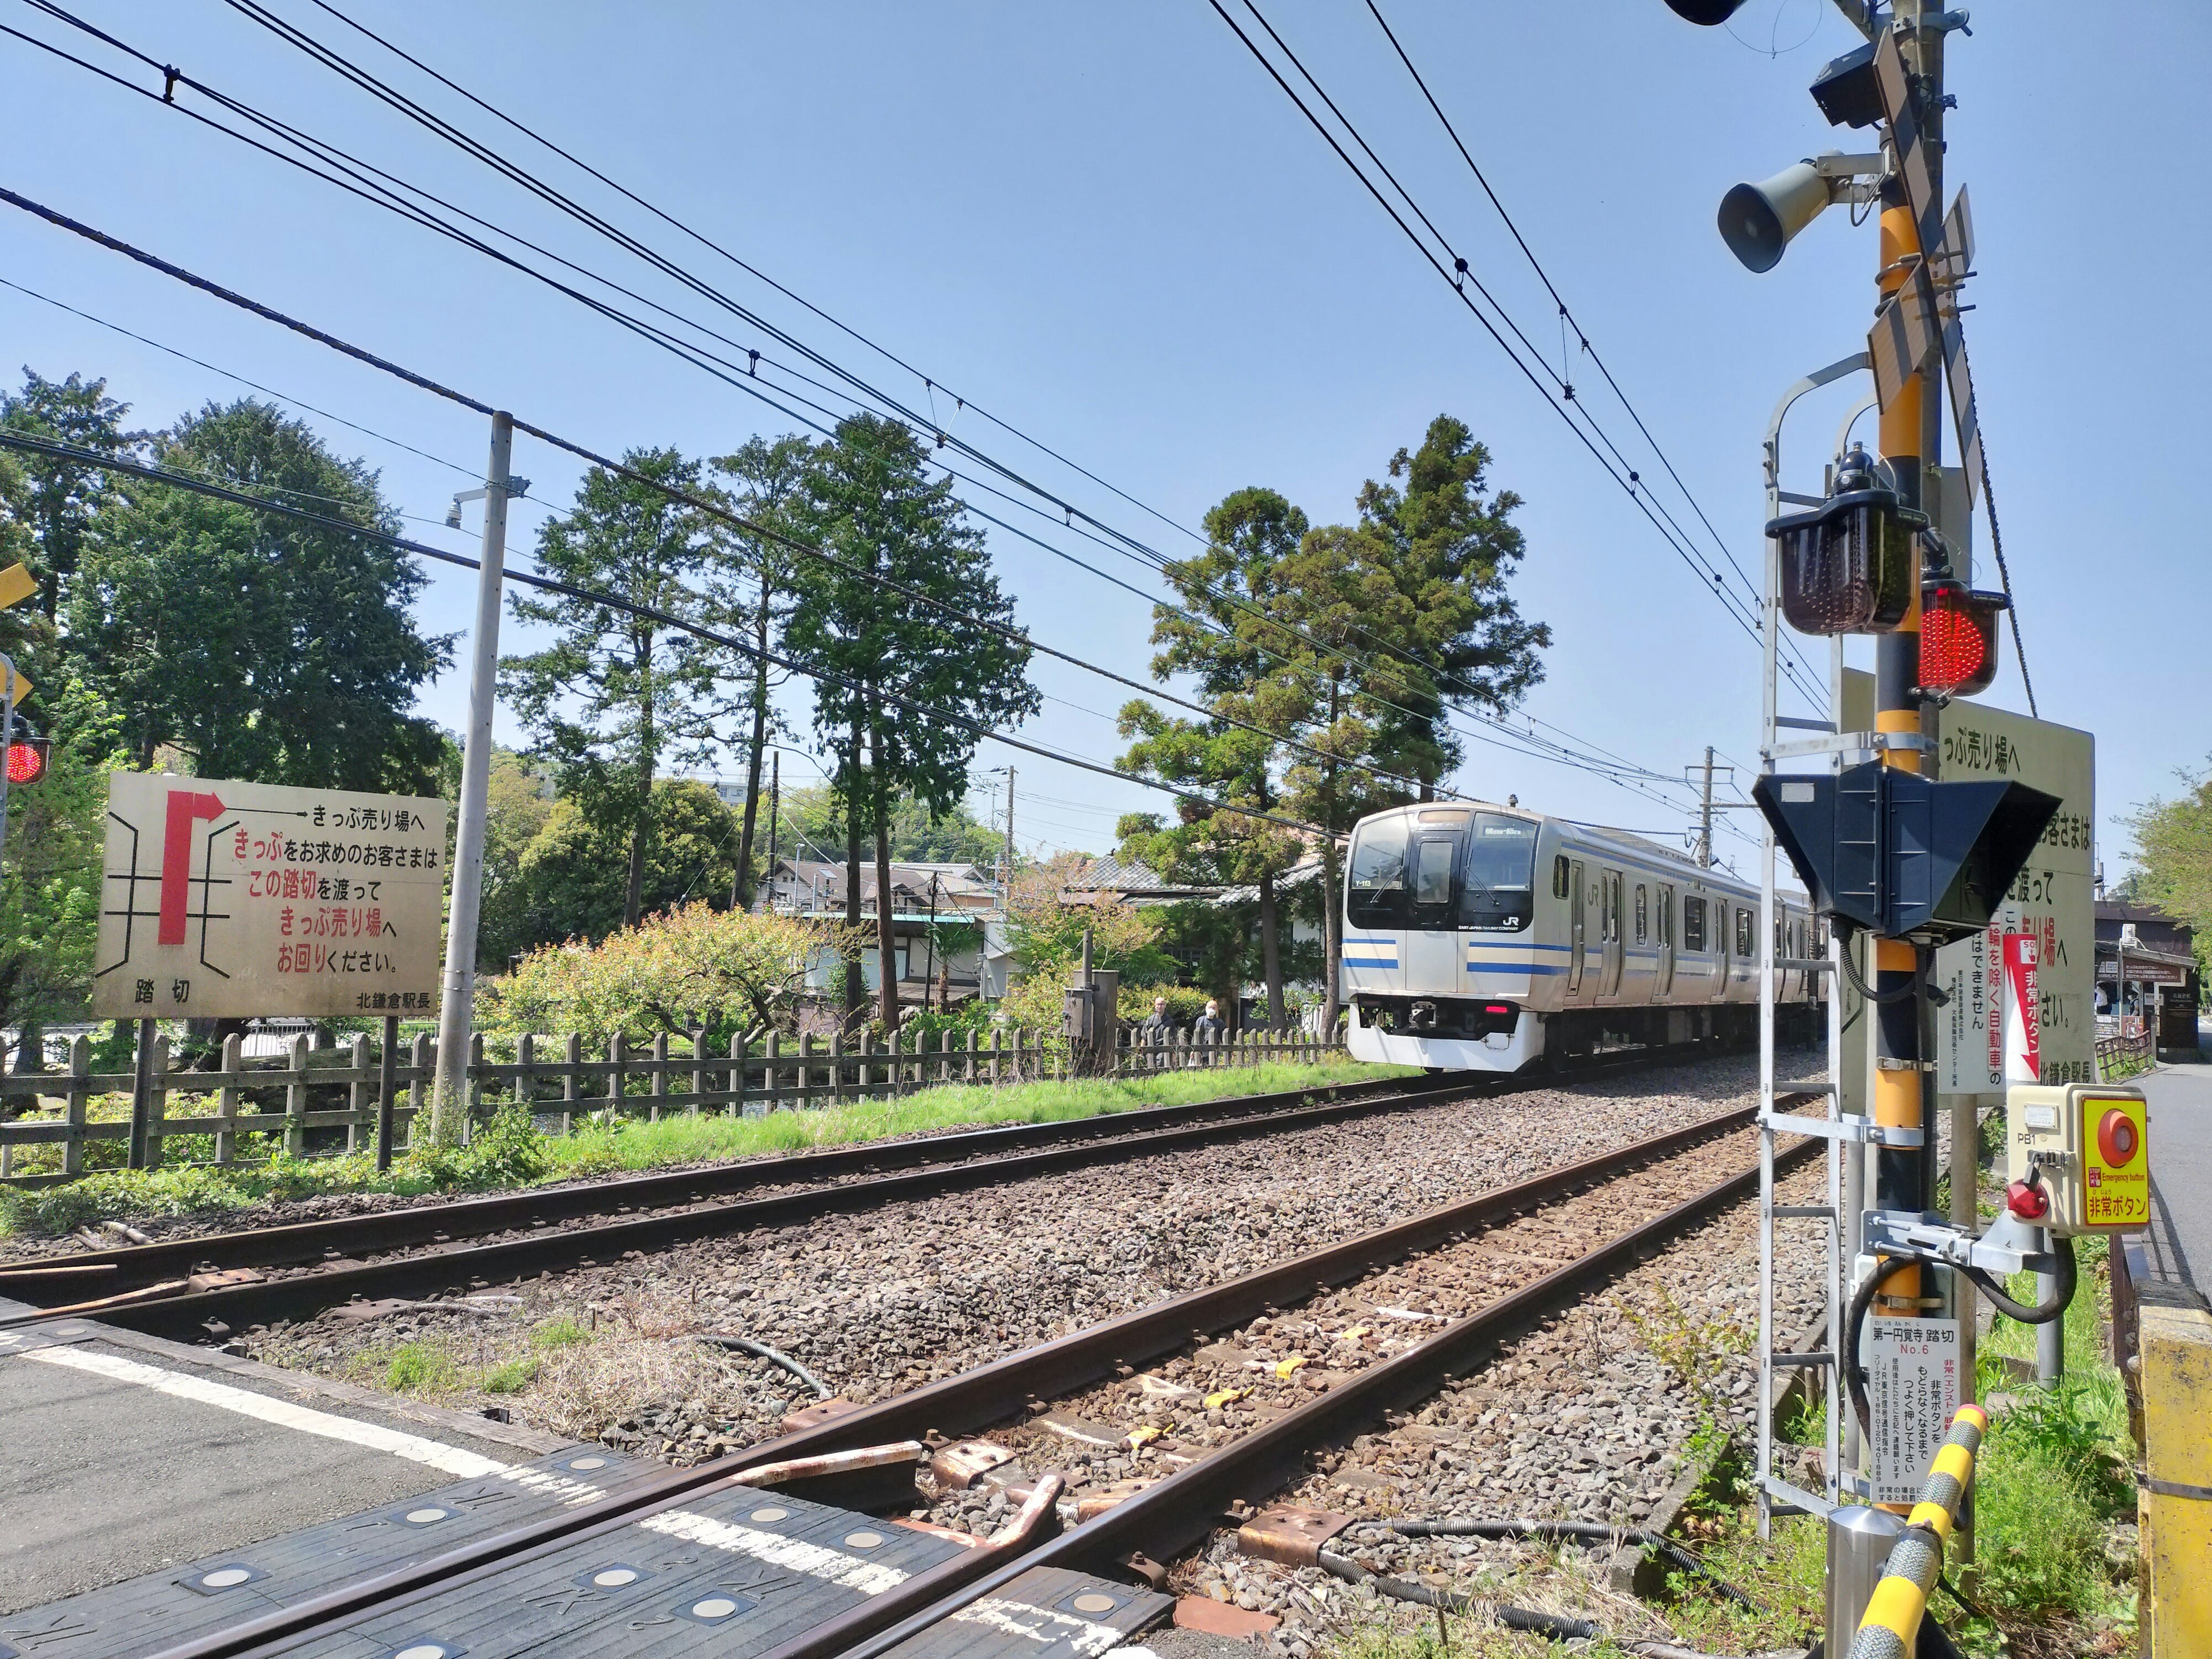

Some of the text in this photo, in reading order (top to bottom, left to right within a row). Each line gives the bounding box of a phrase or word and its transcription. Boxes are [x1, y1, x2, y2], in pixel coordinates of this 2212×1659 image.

[313, 805, 425, 832] きっぷ売り場へ
[234, 828, 438, 869] きっぷをお求めのお客さまは
[249, 869, 381, 901] この踏切を渡って
[1588, 884, 1599, 907] JR
[280, 907, 397, 938] きっぷ売り場へ
[1503, 916, 1519, 926] JR
[277, 943, 397, 973] お回りください。
[135, 979, 191, 1004] 踏切
[357, 993, 431, 1010] 北鎌倉駅長
[2017, 1132, 2036, 1145] PB1
[2102, 1172, 2145, 1183] Emergency button
[2089, 1195, 2146, 1218] 非常ボタン
[1873, 1327, 1955, 1343] 第一円覚寺 踏切
[1900, 1344, 1929, 1354] No.6
[1918, 1366, 1928, 1460] もどらなくなるまで
[1930, 1379, 1941, 1443] 非常ボタンを
[1904, 1380, 1915, 1473] つよく押して下さい
